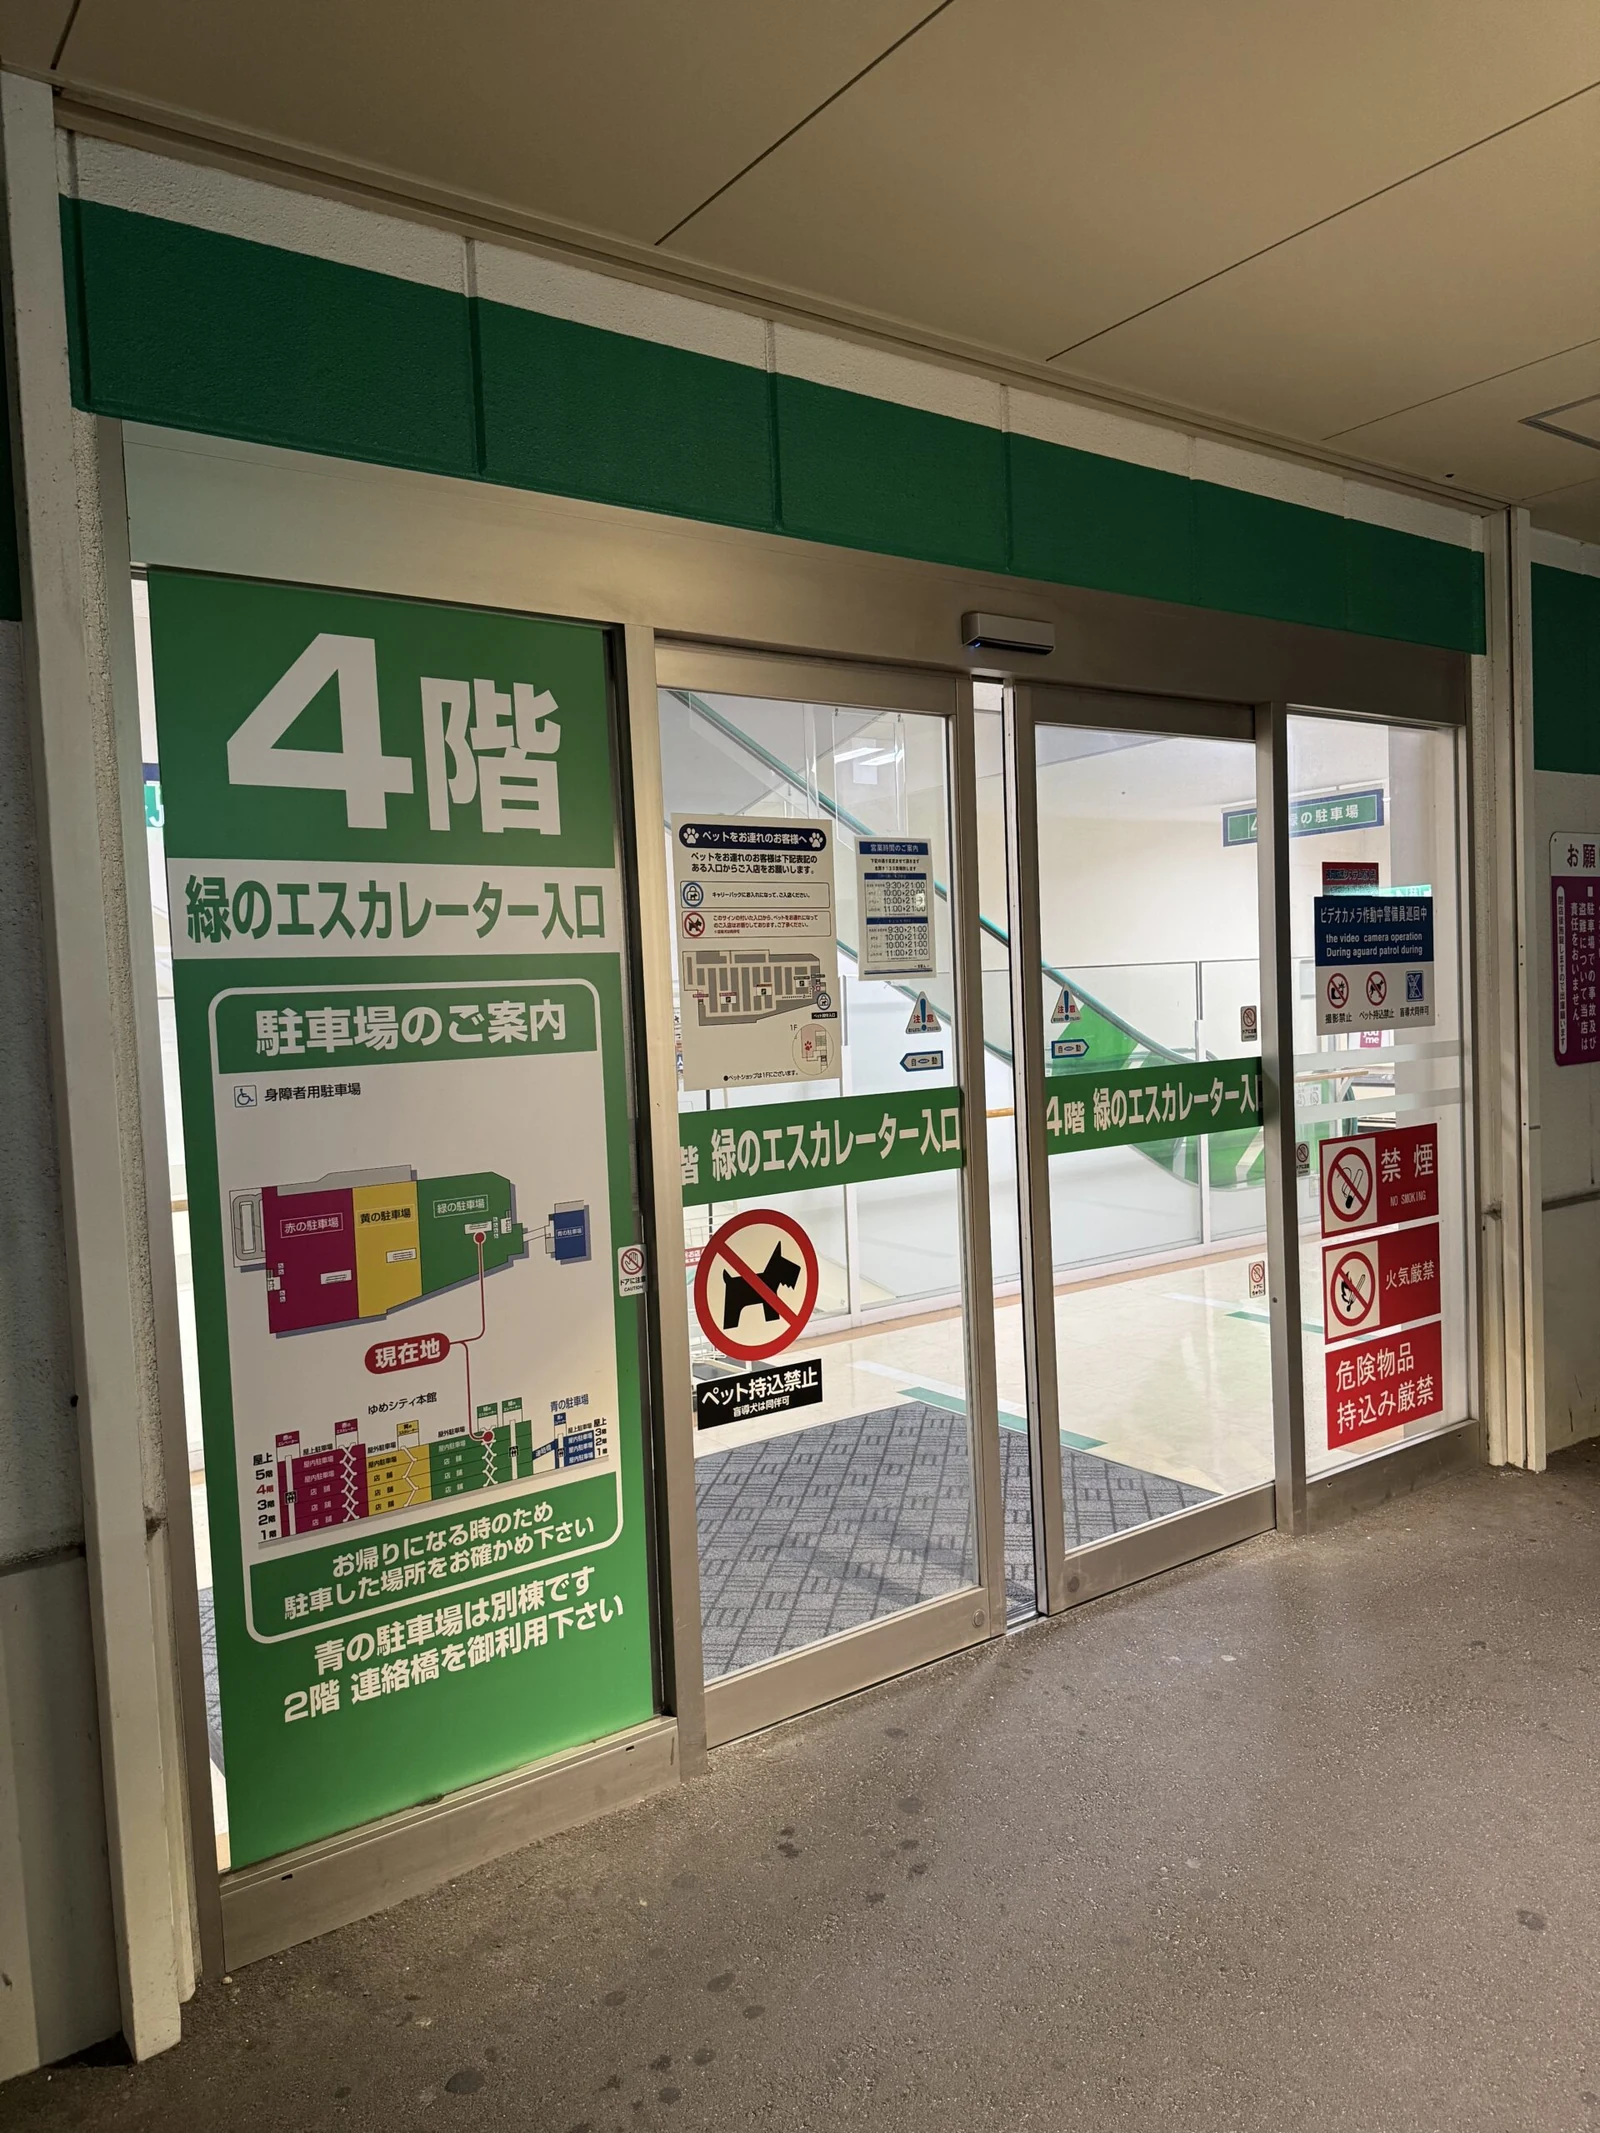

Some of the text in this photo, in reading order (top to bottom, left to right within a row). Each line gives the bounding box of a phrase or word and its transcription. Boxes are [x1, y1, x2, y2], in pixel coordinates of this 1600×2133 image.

[227, 632, 561, 835] 4階
[702, 831, 808, 845] ペットをお連れのお客様へ
[1567, 843, 1600, 868] お願
[185, 874, 606, 944] 緑のエスカレーター入口
[1320, 905, 1428, 924] ビデオカメラ作動中警備員巡回中
[1326, 931, 1423, 943] the video camera operation
[1326, 945, 1423, 958] During aguard patrol during
[255, 998, 567, 1057] 駐車場のご案内
[264, 1082, 361, 1102] 身障者用駐車場
[1046, 1074, 1260, 1137] 4階 緑のエスカレーター入
[710, 1107, 961, 1183] 緑のエスカレーター入口
[436, 1199, 485, 1215] 緑の駐車場
[1400, 1190, 1427, 1205] SMOKING
[284, 1217, 340, 1235] 赤の駐車場
[360, 1208, 411, 1224] 黄の駐車場
[1385, 1259, 1435, 1291] 火気厳禁
[374, 1337, 441, 1369] 現在地
[1335, 1342, 1414, 1393] 危険物品
[701, 1366, 819, 1406] ペット持込禁止
[368, 1392, 438, 1415] ゆめシティ本館
[733, 1395, 790, 1418] 盲導犬は同伴可
[1336, 1373, 1434, 1435] 持込み厳禁
[253, 1452, 273, 1466] 屋上
[255, 1469, 273, 1481] 5階
[256, 1484, 274, 1495] 4階
[257, 1499, 275, 1511] 3階
[258, 1514, 276, 1526] 2階
[260, 1529, 277, 1540] 1階
[332, 1501, 554, 1578] お帰りになる時のため
[284, 1516, 595, 1621] 駐車した場所をお確かめ下さい
[314, 1565, 596, 1676] 青の駐車場は別棟です
[284, 1595, 624, 1723] 2階 連絡橋を御利用下さい
